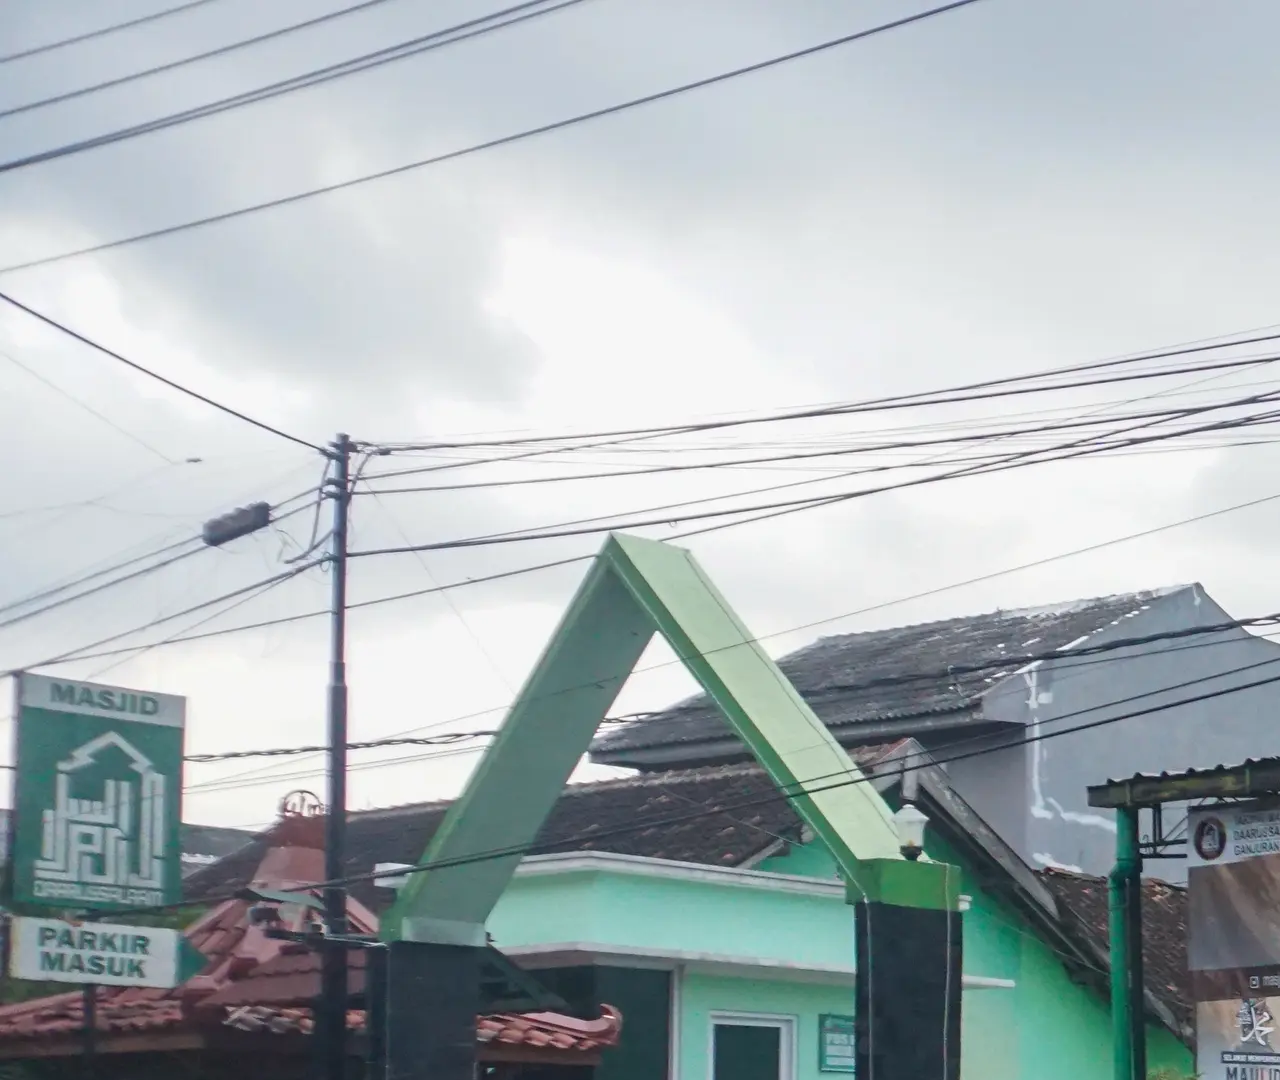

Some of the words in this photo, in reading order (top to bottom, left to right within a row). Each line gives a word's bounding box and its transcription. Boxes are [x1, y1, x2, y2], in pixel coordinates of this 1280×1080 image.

[50, 682, 159, 716] MASJID
[1234, 841, 1280, 856] GANJURAN
[38, 926, 151, 956] PARKIR
[40, 952, 147, 979] MASUK
